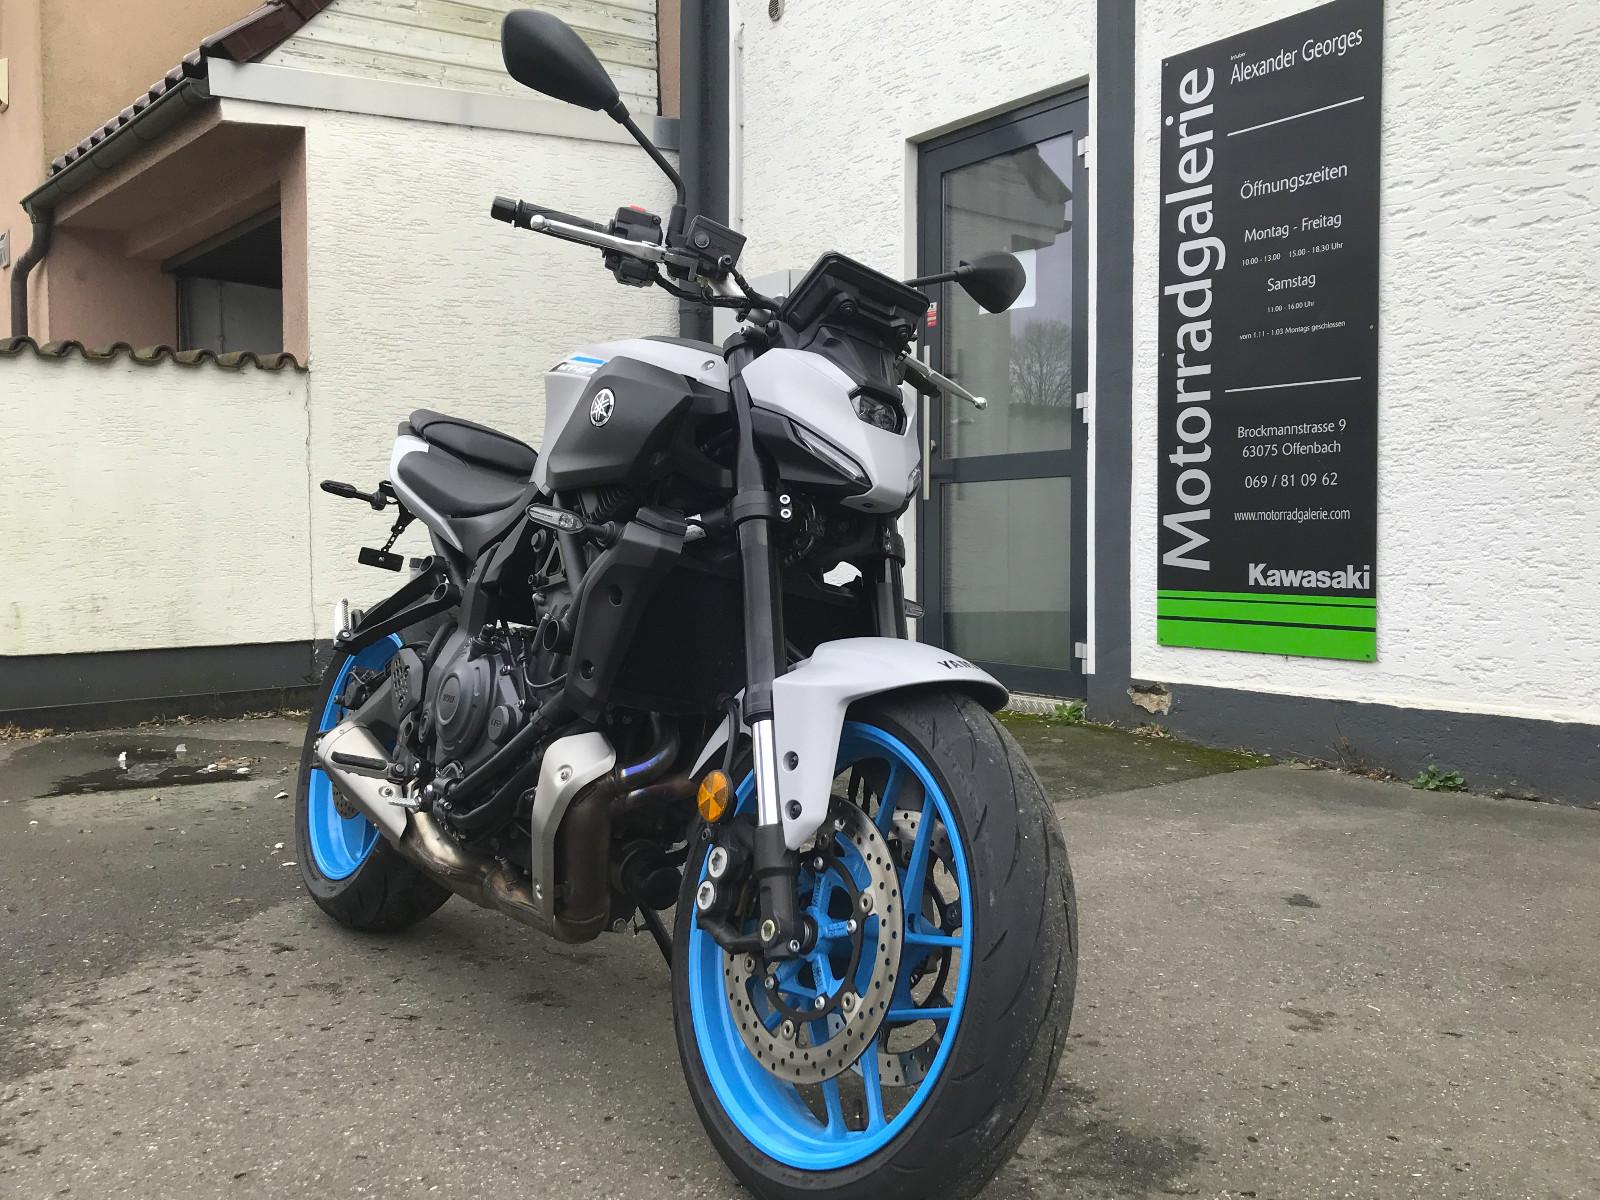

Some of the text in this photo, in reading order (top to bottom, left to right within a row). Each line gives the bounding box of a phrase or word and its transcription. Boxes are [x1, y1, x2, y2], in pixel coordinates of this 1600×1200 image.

[1230, 28, 1363, 85] Alexander Georges
[1240, 164, 1348, 199] Öffnungszeiten
[1244, 224, 1290, 243] Montag
[1302, 214, 1342, 232] Freitag
[1264, 252, 1281, 262] 13.00
[1289, 248, 1306, 258] 15.00
[1312, 243, 1330, 254] 18.30
[1331, 241, 1344, 250] Uhr
[1267, 274, 1316, 292] Samstag
[1288, 301, 1303, 310] 16.00
[1304, 300, 1315, 308] Uhr
[1162, 66, 1226, 571] Motorradgalerie
[1311, 320, 1345, 332] geschlossen
[1237, 418, 1347, 438] Brockmannstrasse 9
[1242, 440, 1341, 458] 63075 Offenbach
[1244, 475, 1268, 489] 069
[1280, 473, 1295, 487] 81
[1300, 472, 1317, 487] 09
[1321, 471, 1339, 486] 62
[1234, 507, 1351, 524] www.motorradgalerie.com
[1248, 563, 1371, 590] Kawasaki
